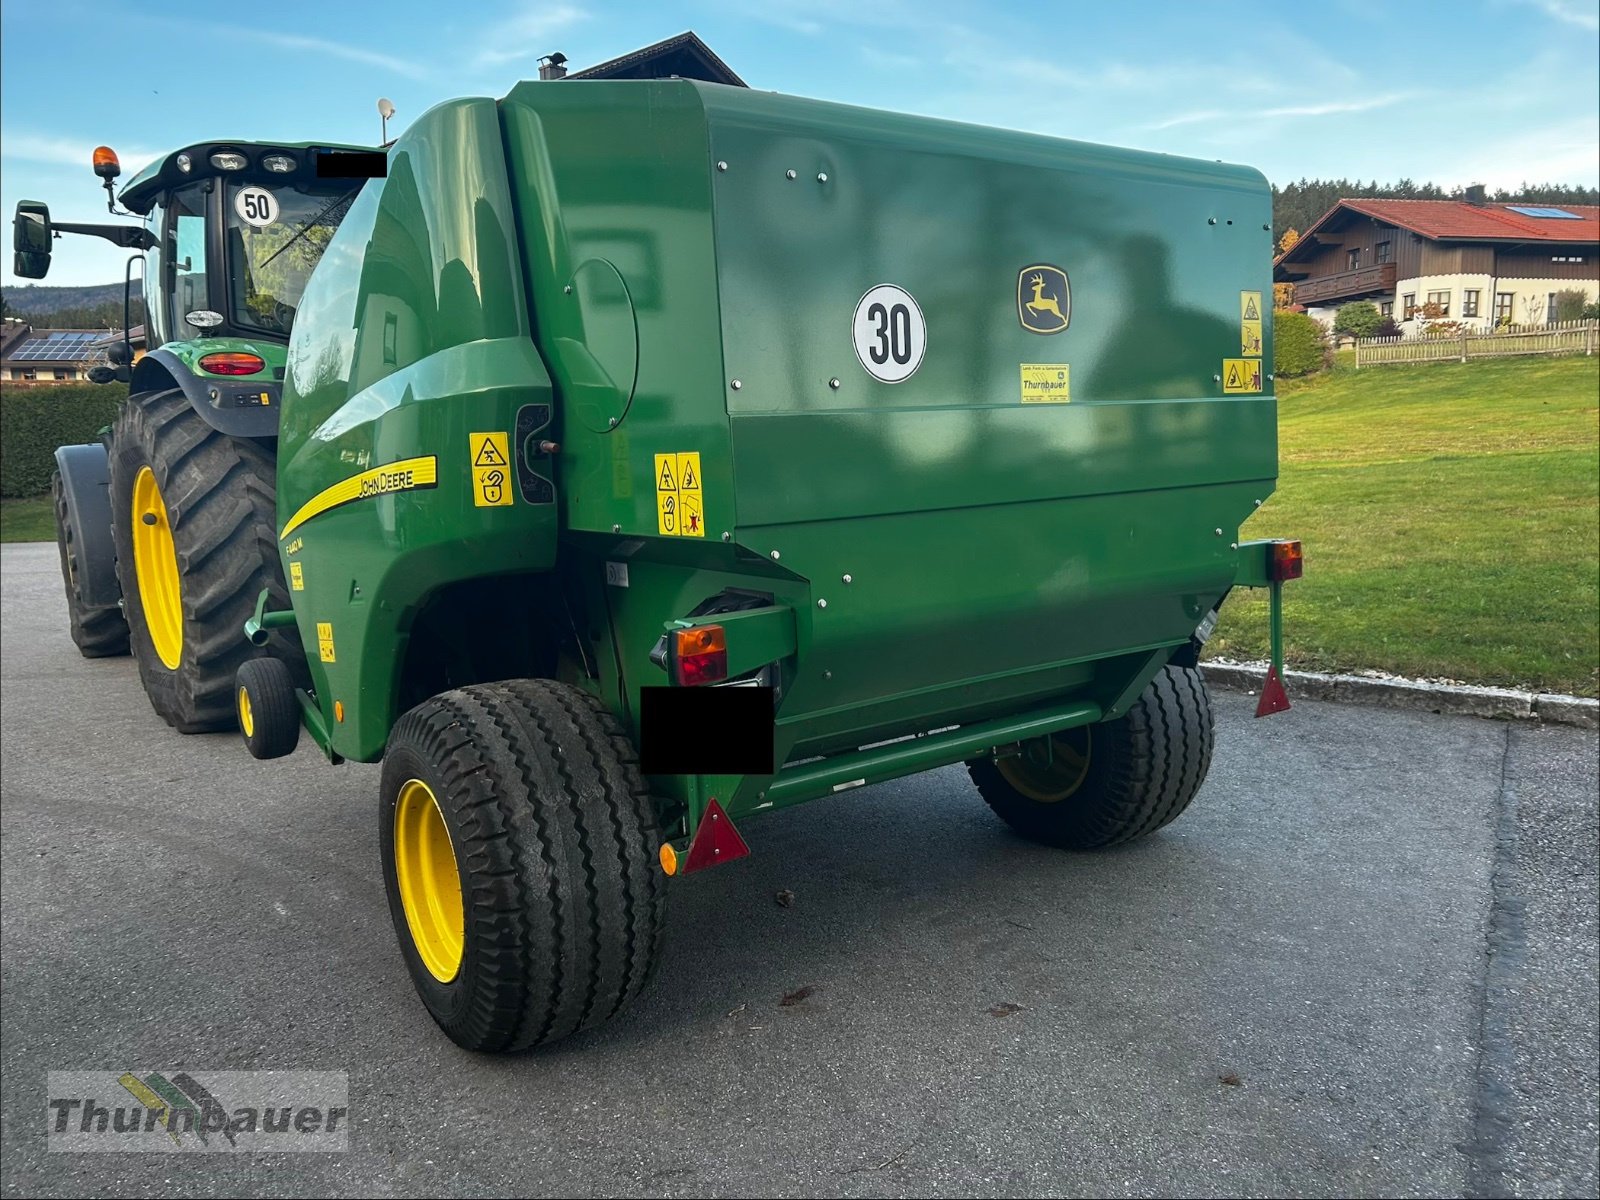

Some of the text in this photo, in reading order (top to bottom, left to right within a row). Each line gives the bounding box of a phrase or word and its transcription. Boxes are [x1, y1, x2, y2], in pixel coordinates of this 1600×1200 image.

[244, 193, 269, 220] 50
[867, 302, 912, 365] 30
[1023, 380, 1066, 389] Thurnbauer
[359, 470, 413, 496] JOHN DEERE
